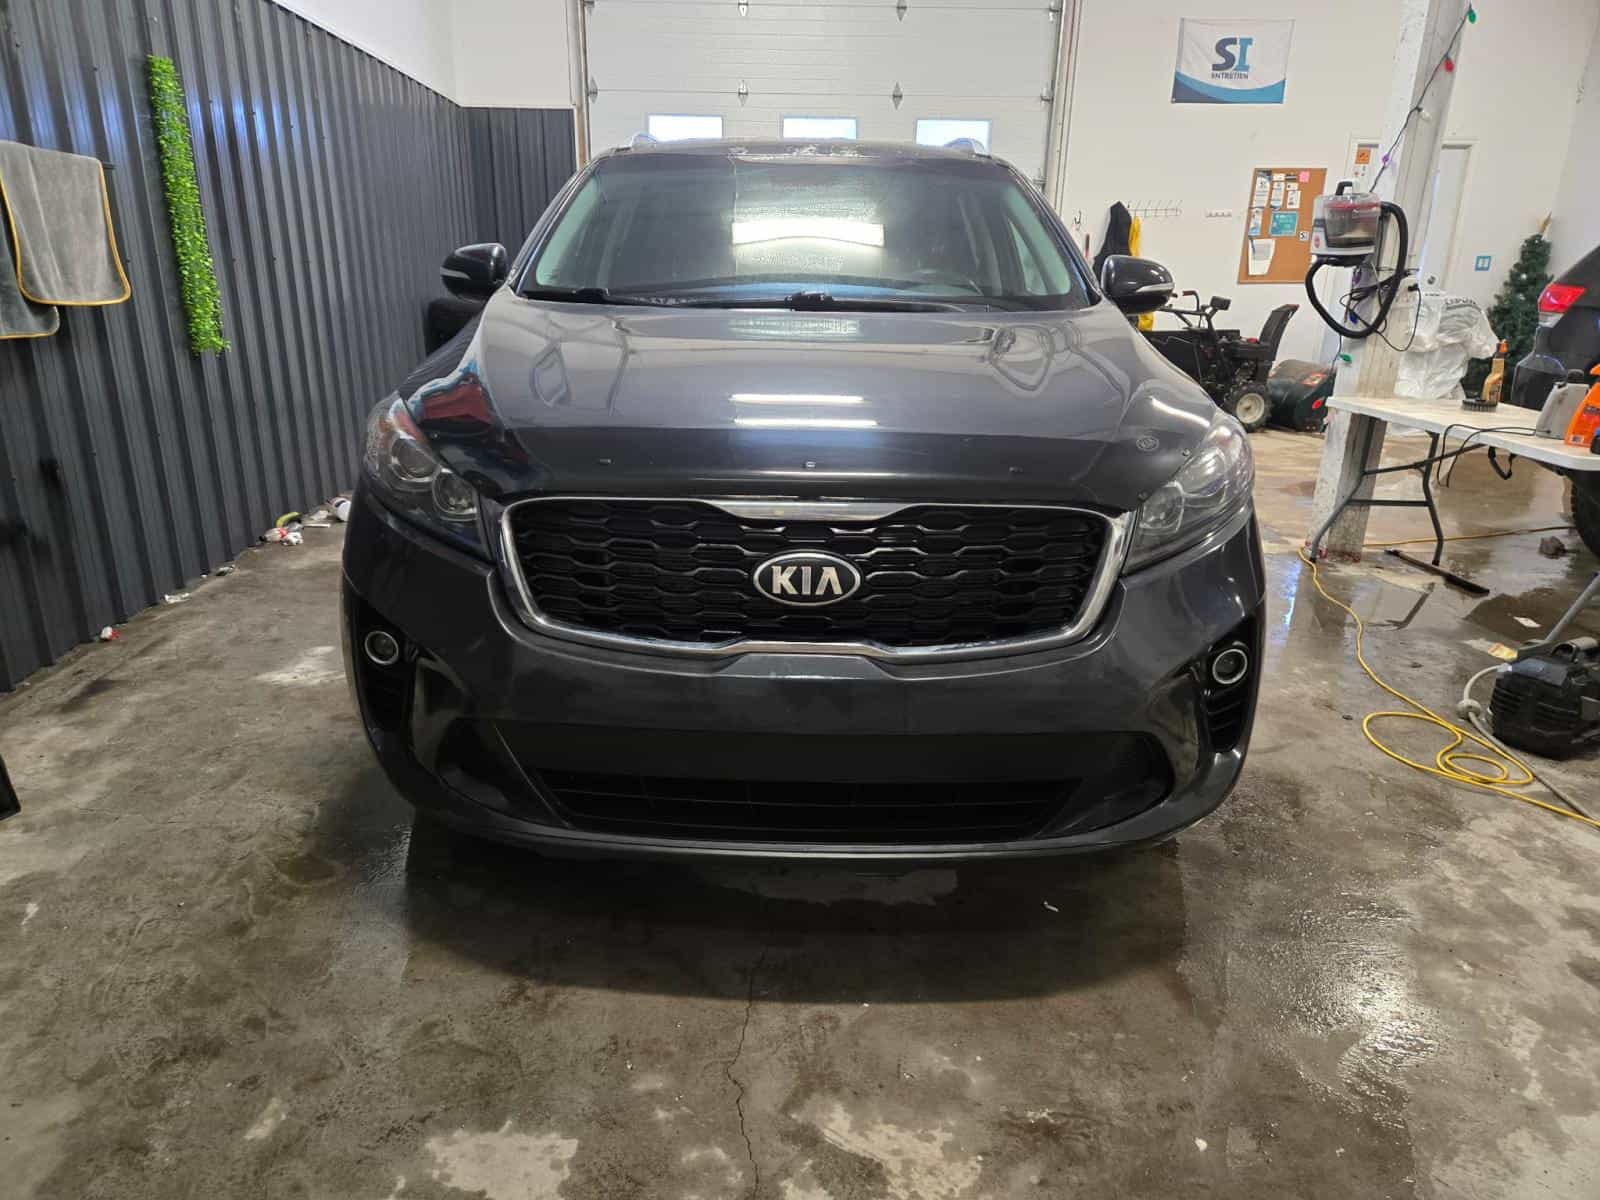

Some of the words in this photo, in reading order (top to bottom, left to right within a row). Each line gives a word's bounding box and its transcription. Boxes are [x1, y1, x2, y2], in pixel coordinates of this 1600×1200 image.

[1212, 37, 1253, 71] SI
[1211, 72, 1249, 80] ENTRETIEN
[771, 566, 843, 595] KIA
